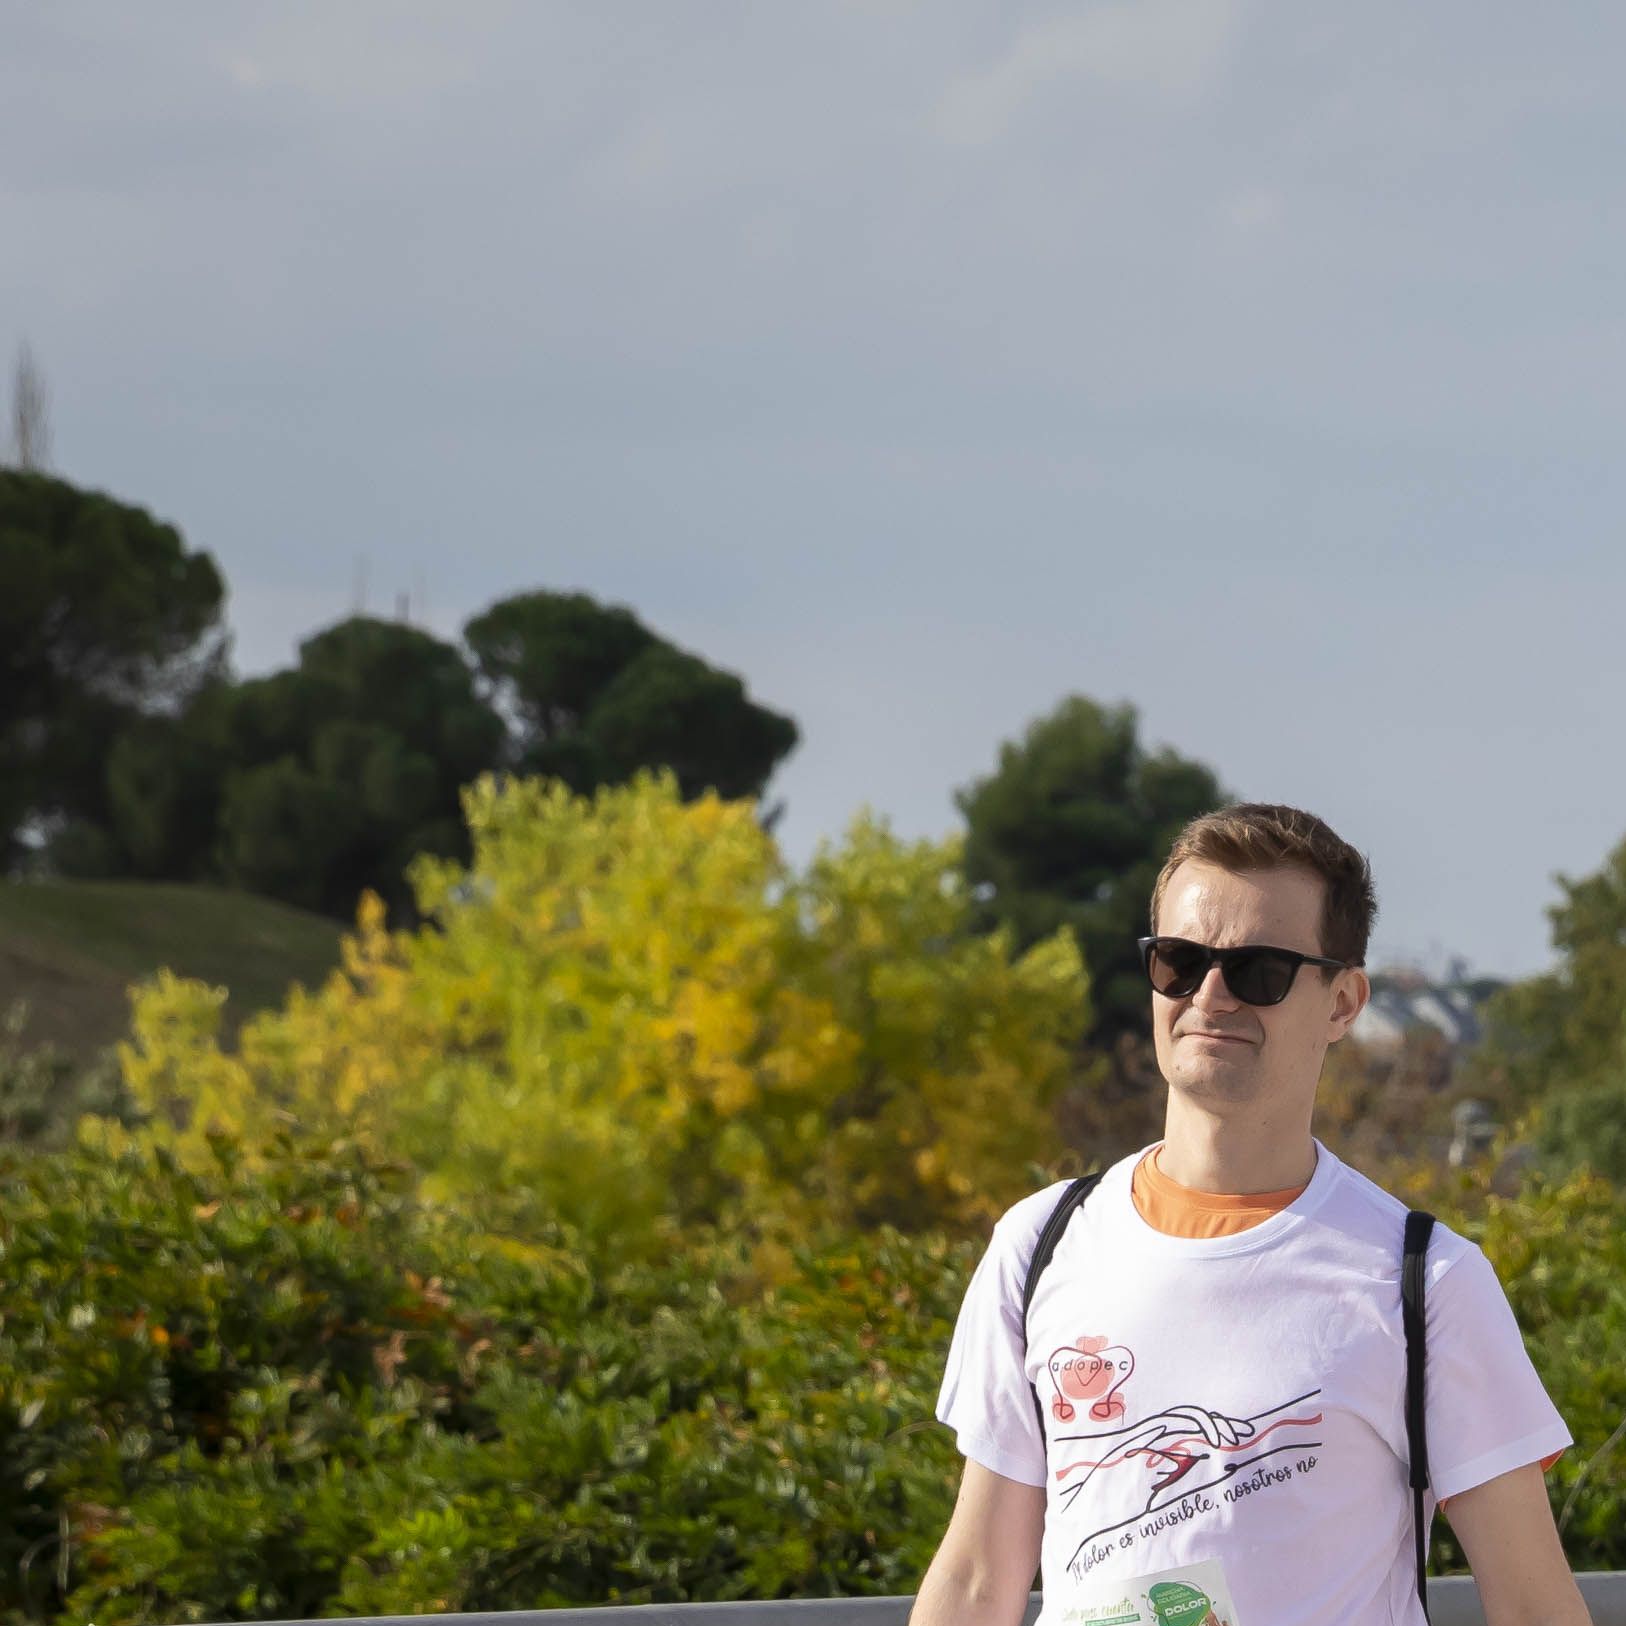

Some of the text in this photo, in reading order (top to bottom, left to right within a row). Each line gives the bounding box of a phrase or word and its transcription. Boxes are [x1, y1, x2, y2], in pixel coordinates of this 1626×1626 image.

[1051, 1359, 1129, 1374] adopec
[1120, 1533, 1135, 1549] es
[1223, 1467, 1292, 1502] nosotros
[1296, 1456, 1319, 1473] no
[1164, 1598, 1207, 1617] DOLOR
